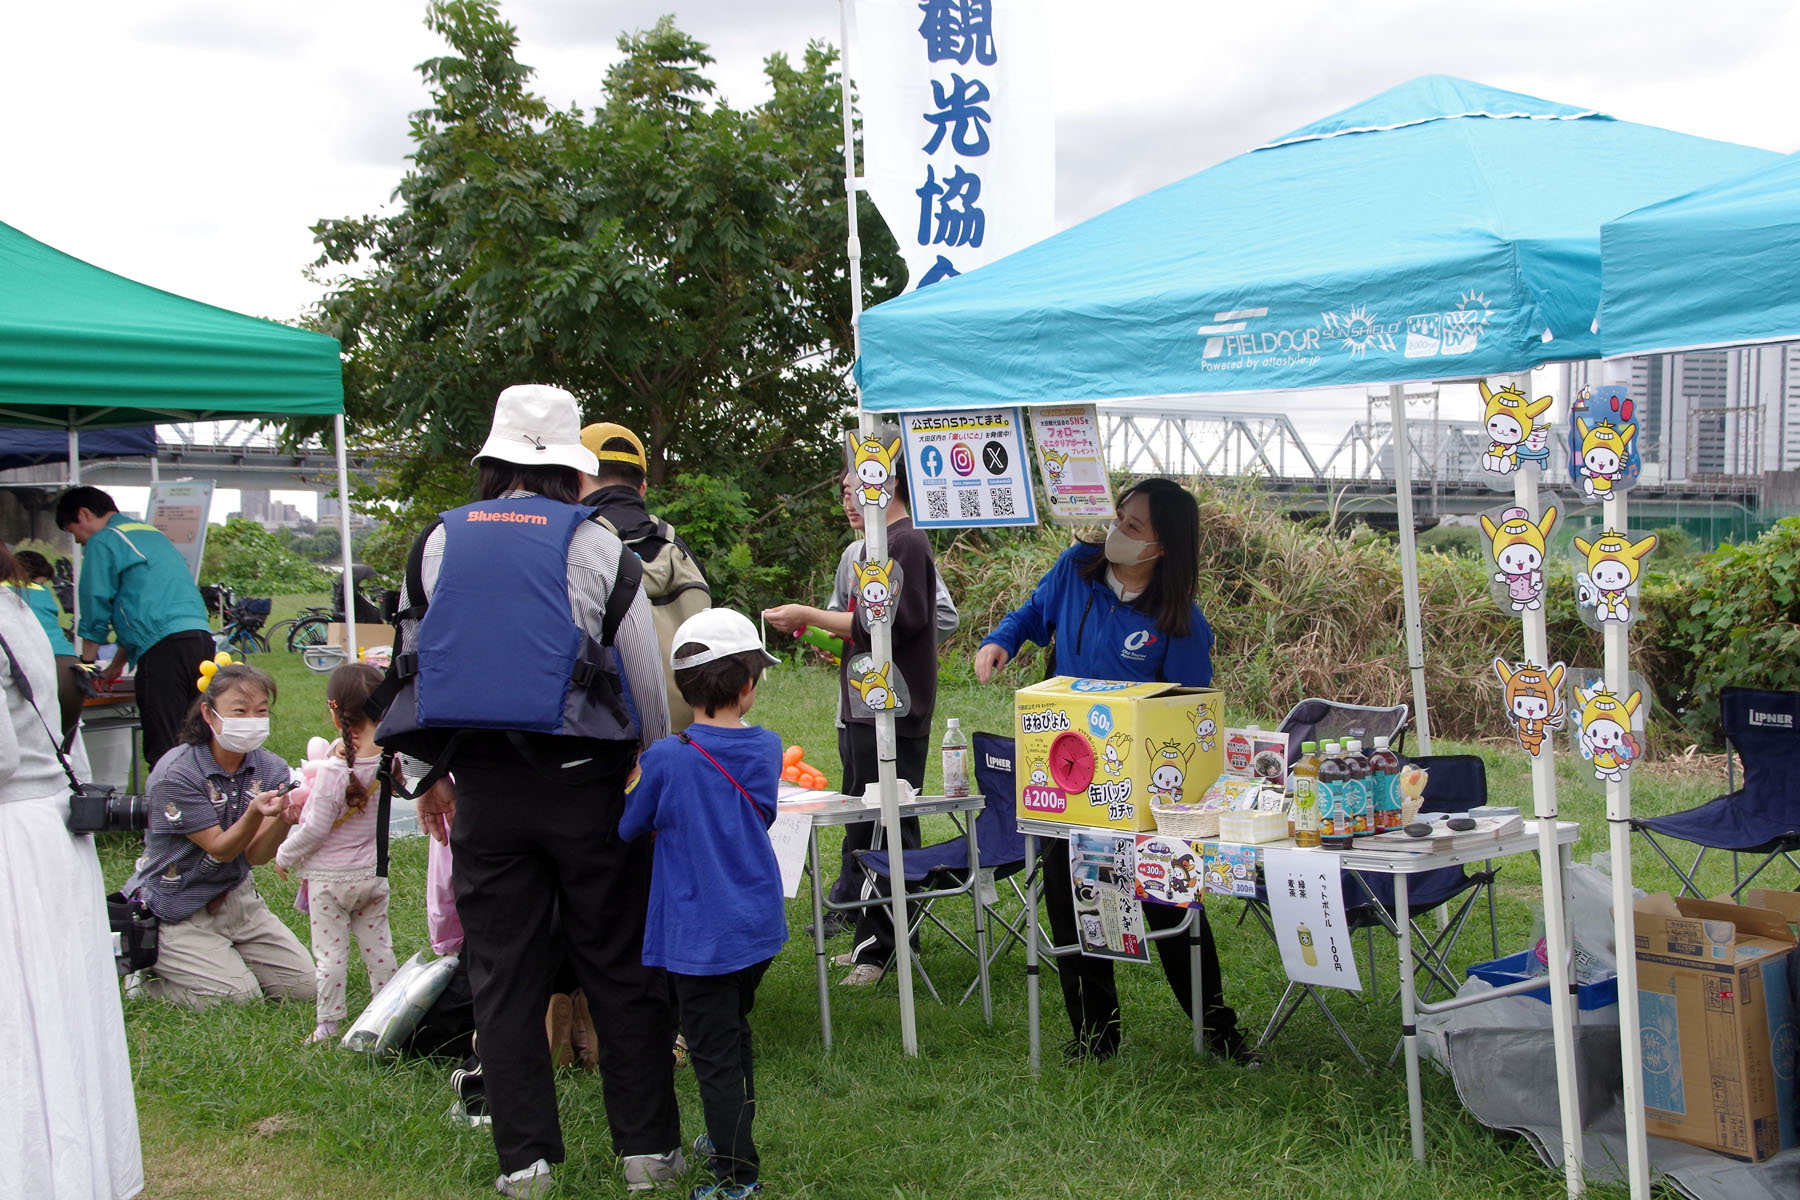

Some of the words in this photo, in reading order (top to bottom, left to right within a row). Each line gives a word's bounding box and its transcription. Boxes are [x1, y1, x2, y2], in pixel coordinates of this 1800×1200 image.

[1351, 323, 1399, 338] SHIELD
[1225, 328, 1320, 356] FIELDOOR
[1201, 357, 1243, 372] Powered
[1246, 355, 1259, 371] by
[466, 510, 548, 526] Bluestorm
[1022, 710, 1069, 731] はねぴょん
[1749, 708, 1793, 726] LIPNER
[1032, 790, 1065, 809] 200円
[1089, 780, 1131, 804] 缶バッジ
[1109, 803, 1133, 818] ガチャ
[1319, 873, 1332, 928] ペットボトル
